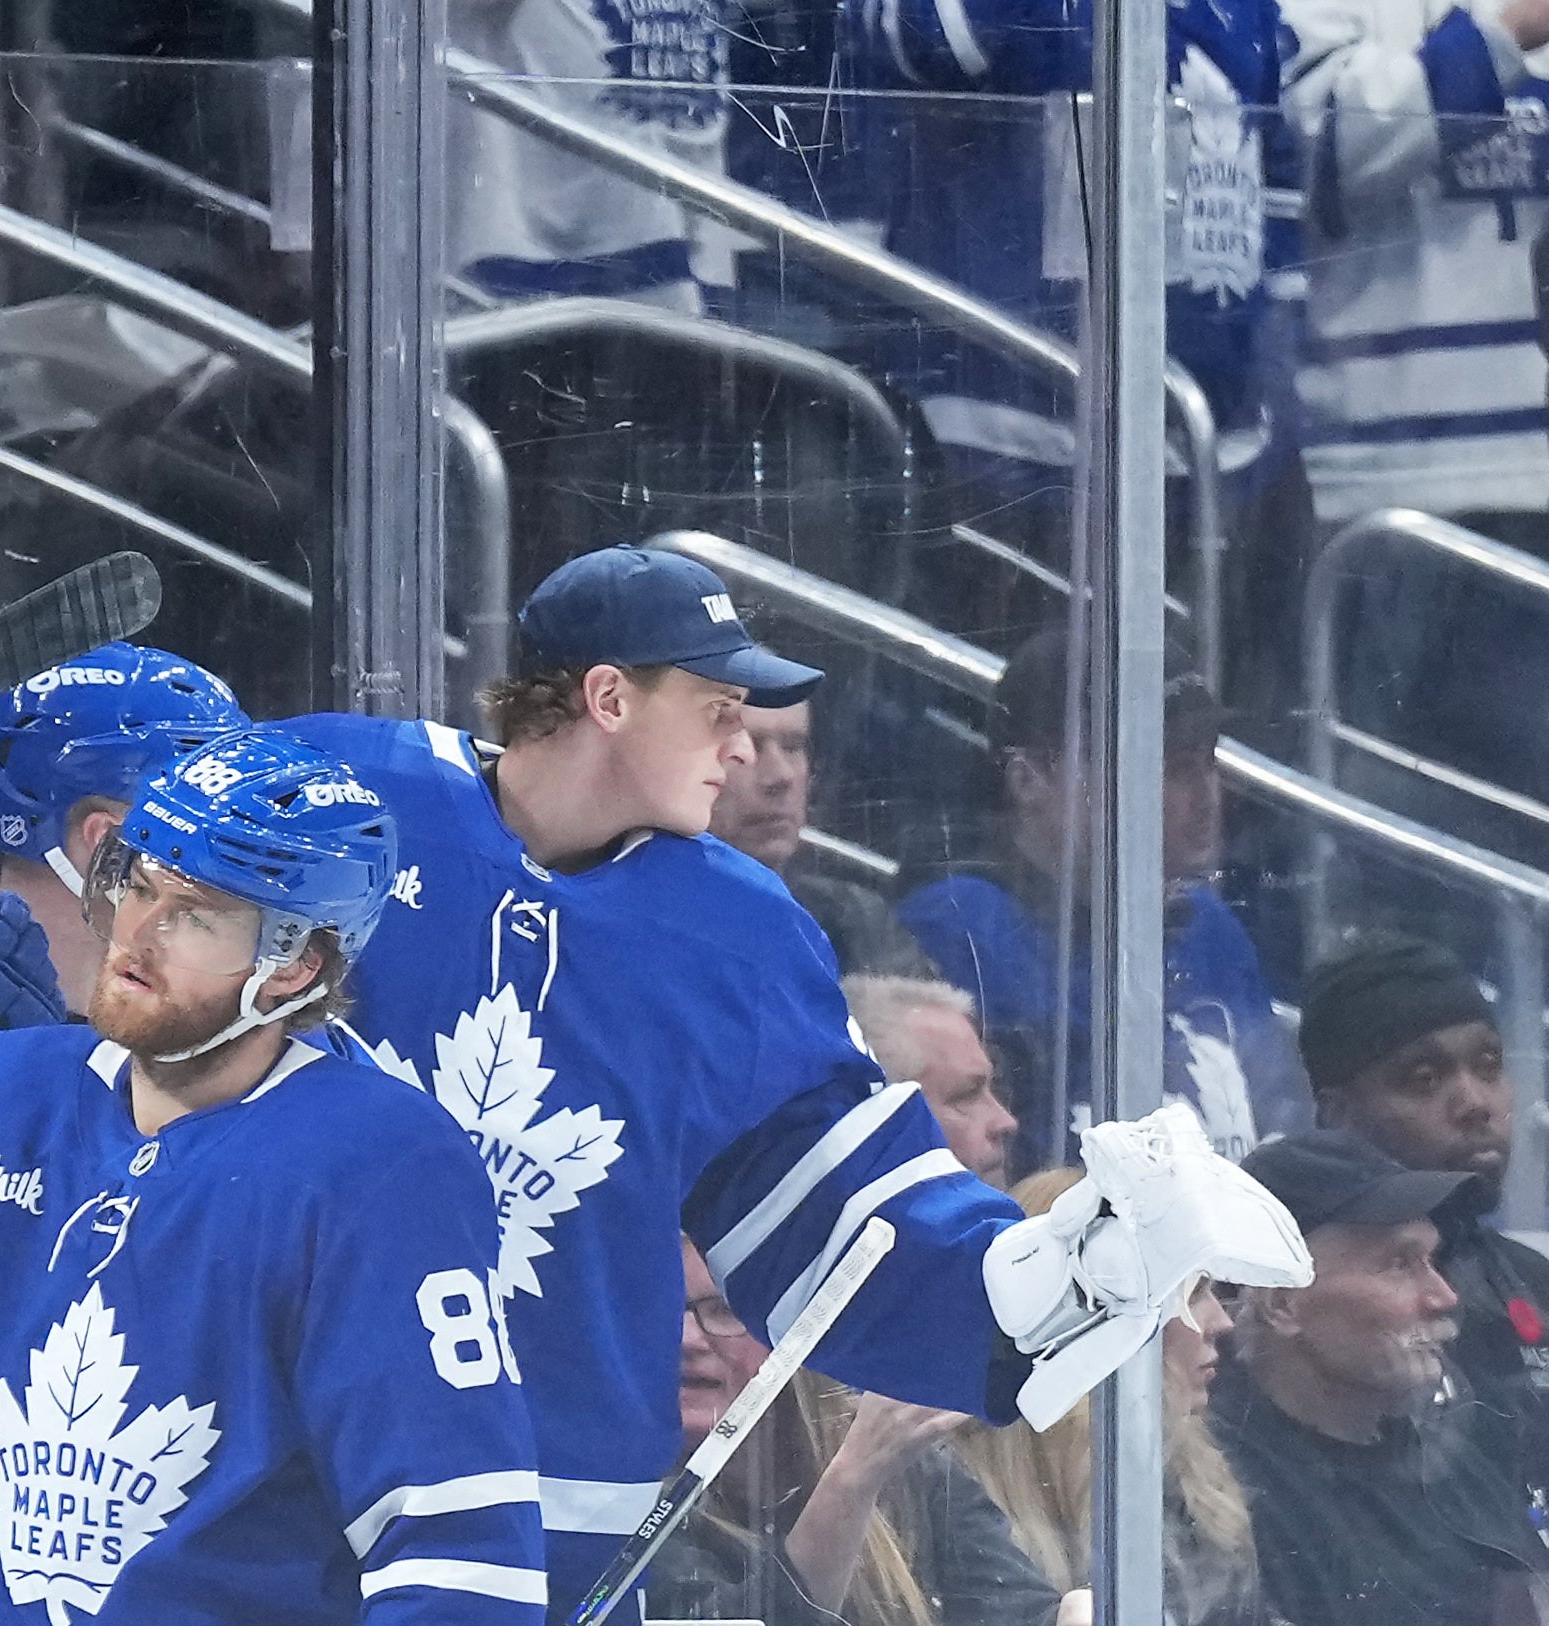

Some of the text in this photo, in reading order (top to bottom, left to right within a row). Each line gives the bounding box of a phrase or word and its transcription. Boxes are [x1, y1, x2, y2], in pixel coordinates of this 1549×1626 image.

[26, 667, 125, 694] OREO
[304, 781, 382, 808] OREO
[390, 865, 423, 909] lk
[415, 1267, 522, 1390] 8
[12, 1483, 124, 1529] MAPLE
[10, 1520, 122, 1565] LEAFS
